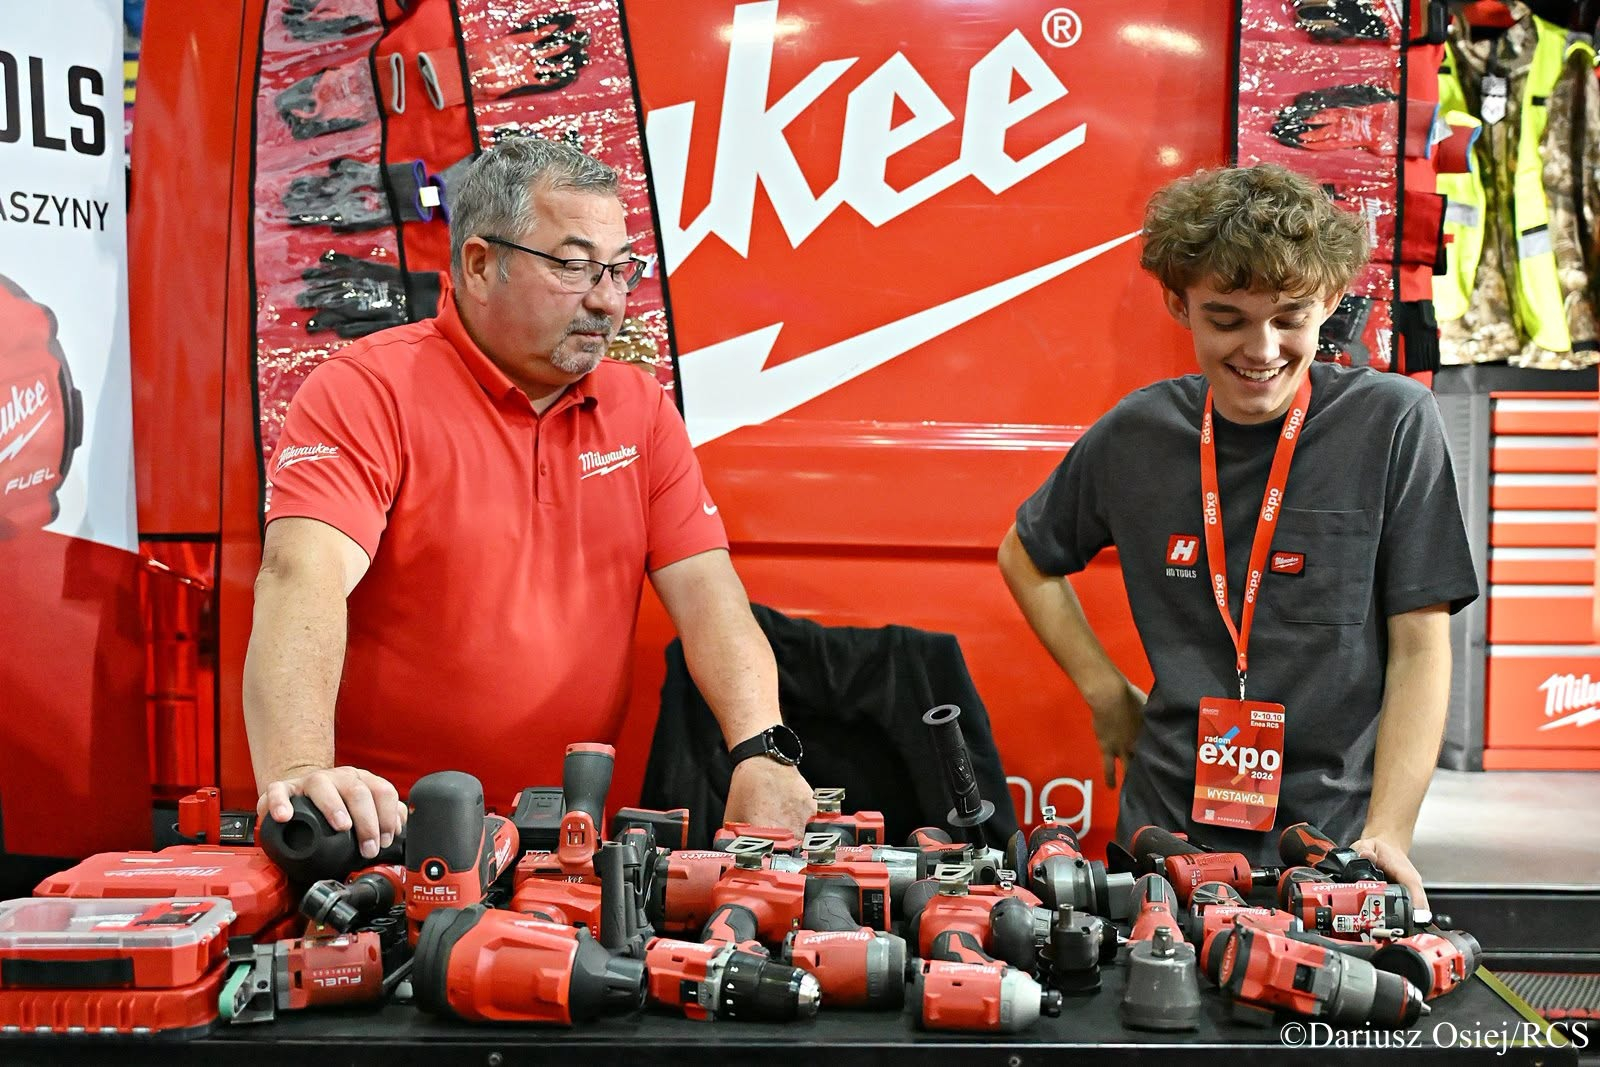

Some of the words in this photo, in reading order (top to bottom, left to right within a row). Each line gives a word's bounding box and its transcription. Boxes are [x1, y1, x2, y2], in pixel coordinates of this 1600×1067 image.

[1203, 412, 1211, 444] expo
[1285, 408, 1302, 440] expo
[276, 442, 338, 469] Milwaukee
[578, 445, 637, 472] Milwaukee
[4, 468, 55, 495] FUEL
[1206, 492, 1217, 525] expo
[1264, 488, 1279, 522] expo
[1175, 568, 1197, 578] TOOLS
[1247, 570, 1259, 603] expo
[1215, 573, 1226, 607] expo
[1252, 712, 1282, 721] 9-10.10
[1266, 721, 1280, 729] RCS
[1204, 735, 1231, 744] radom
[1199, 743, 1280, 774] expo
[1251, 771, 1273, 780] 2026
[1207, 788, 1265, 805] WYSTAWCA
[413, 885, 457, 895] FUEL
[803, 931, 870, 944] Milwaukee
[313, 975, 361, 987] FUEL
